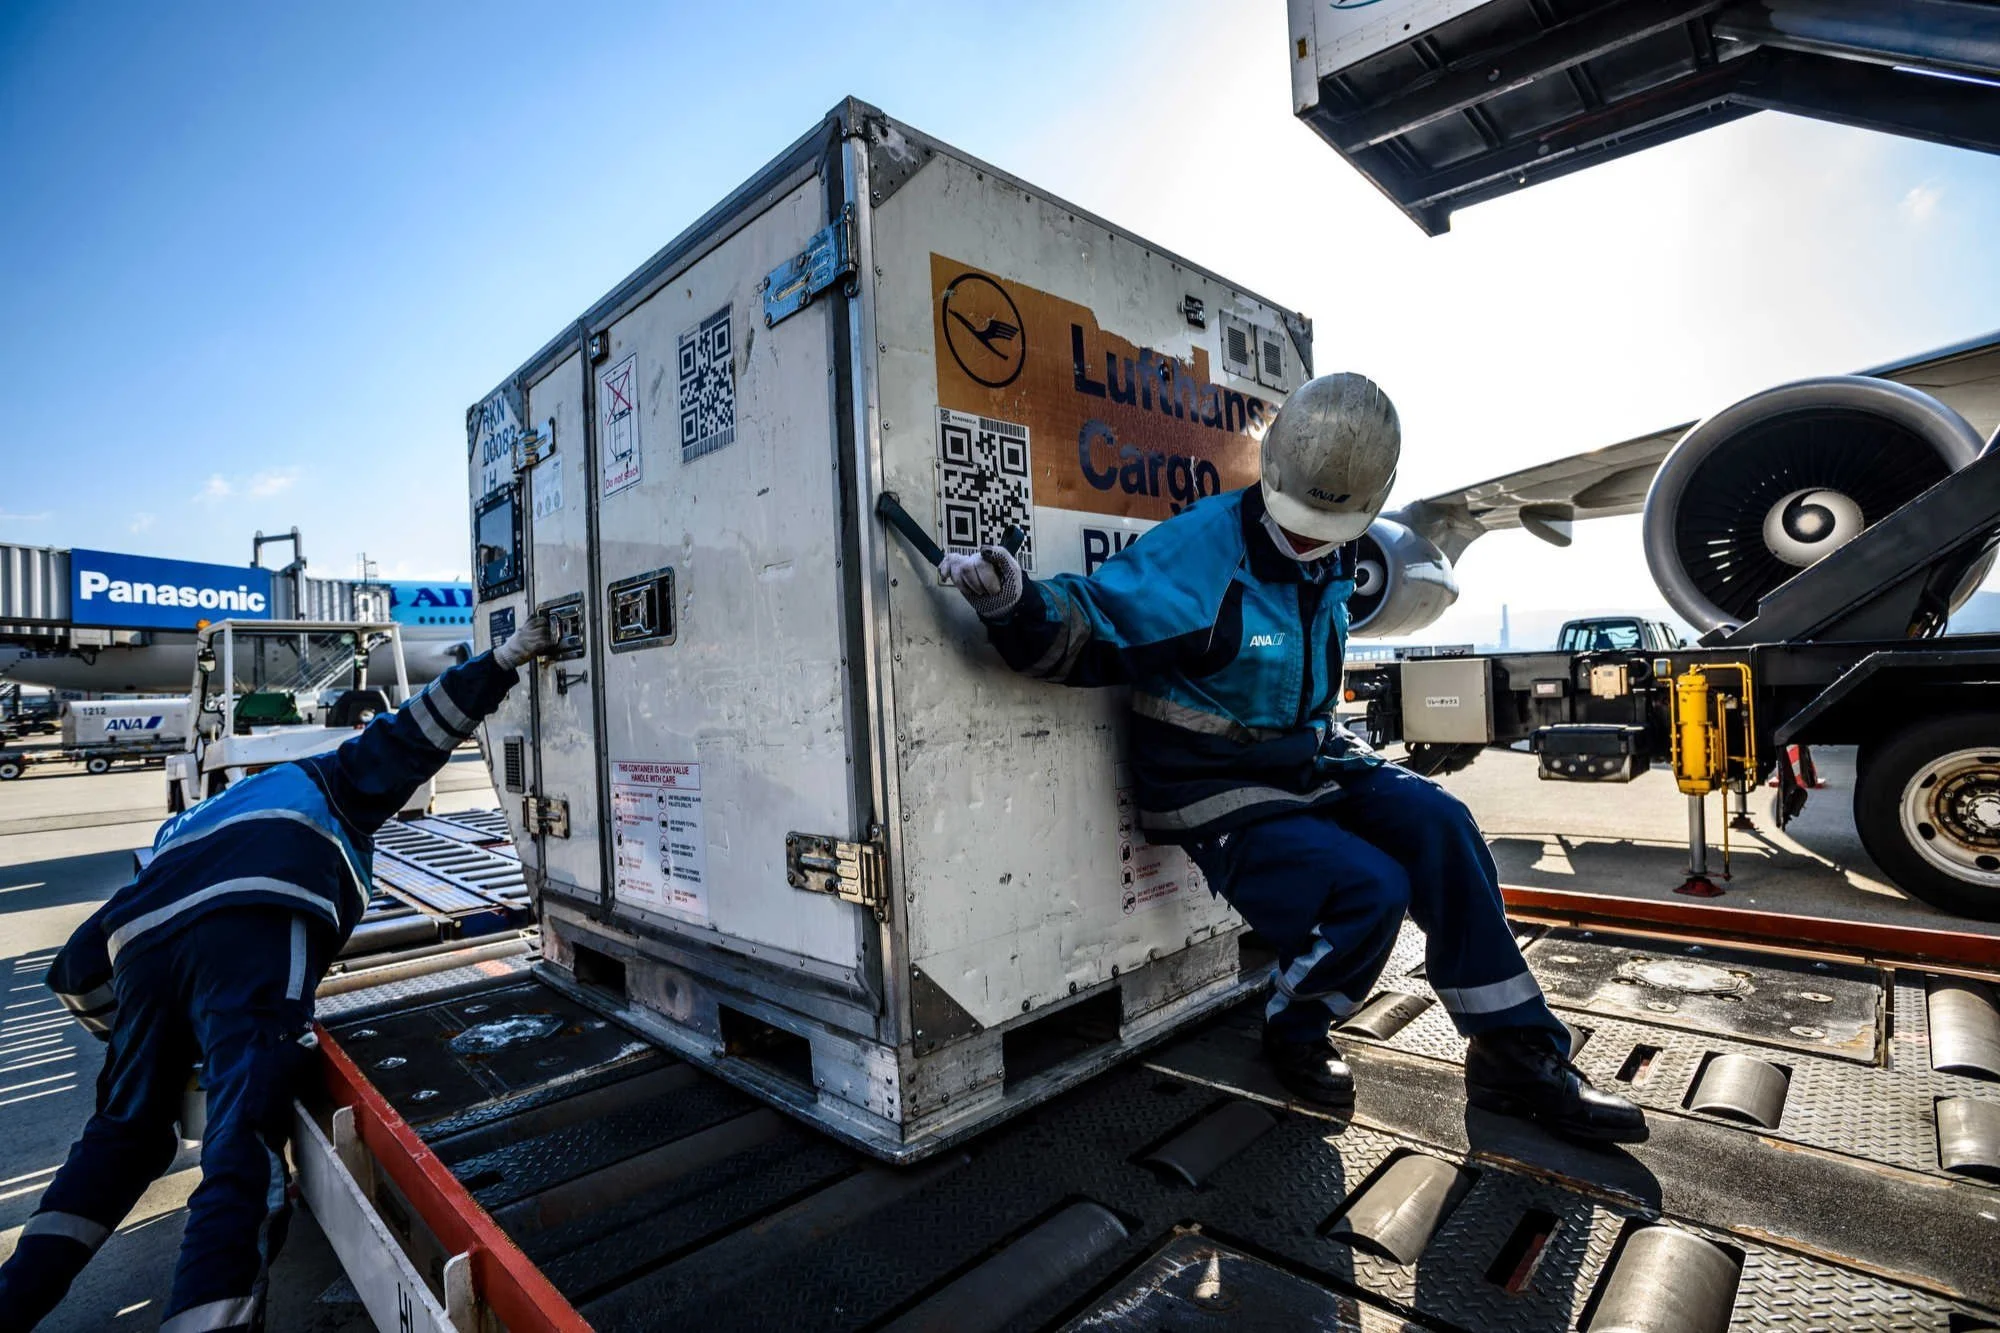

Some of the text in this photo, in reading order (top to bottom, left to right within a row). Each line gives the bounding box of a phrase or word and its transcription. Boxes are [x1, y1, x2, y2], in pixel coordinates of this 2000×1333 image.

[1071, 323, 1281, 440] Lufthans
[1079, 418, 1221, 516] Cargo
[606, 479, 613, 489] Do
[80, 570, 266, 612] Panasonic
[1250, 634, 1273, 647] ANA
[83, 707, 107, 716] 1212
[105, 718, 142, 731] ANA
[628, 764, 654, 773] CONTAINER
[660, 766, 672, 774] HIGH
[672, 766, 689, 775] VALUE
[631, 773, 676, 784] HANDLE WITH CARE
